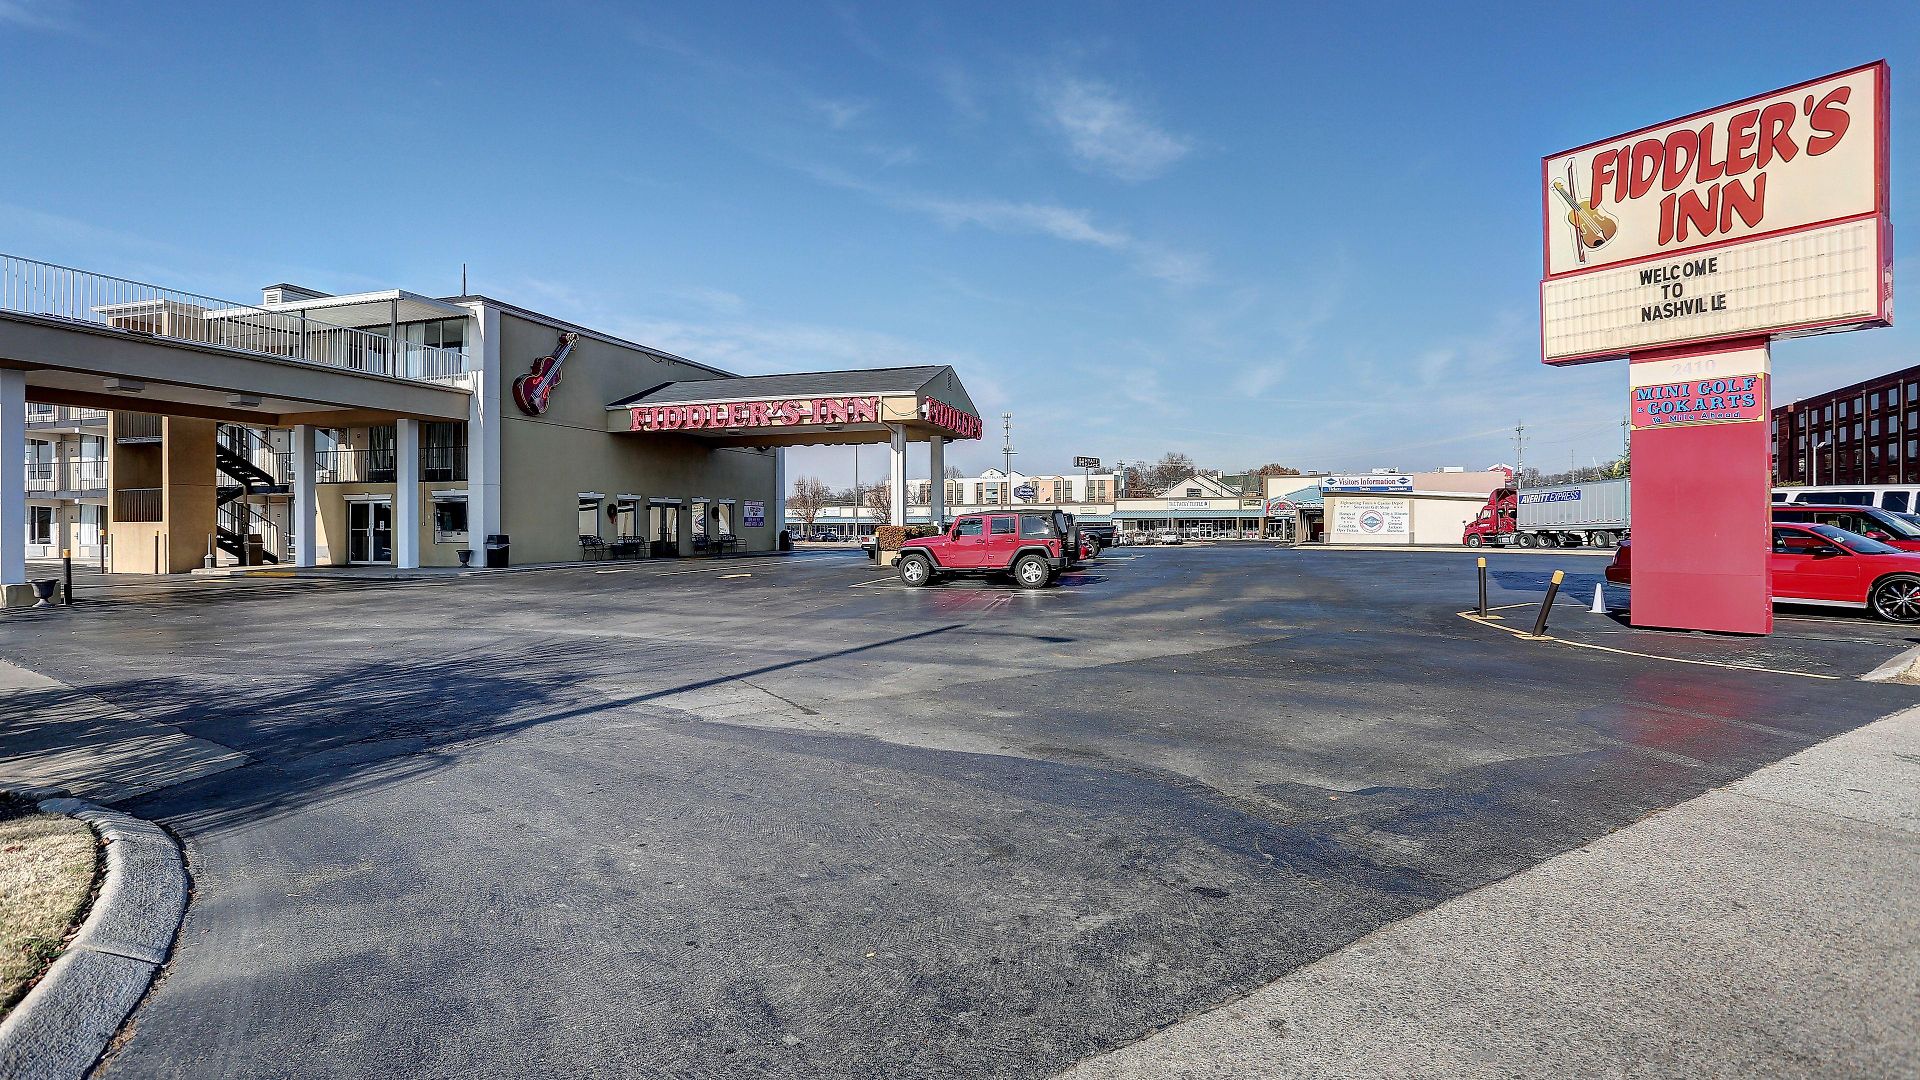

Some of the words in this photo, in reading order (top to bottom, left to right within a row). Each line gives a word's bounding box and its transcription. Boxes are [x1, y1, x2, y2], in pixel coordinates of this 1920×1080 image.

[1589, 86, 1852, 210] FIDDLER'S
[1657, 171, 1768, 247] INN
[1639, 257, 1719, 286] WELCOME
[1661, 282, 1685, 301] TO
[1671, 360, 1716, 376] 2410
[1636, 383, 1690, 401] MINI
[1697, 377, 1757, 396] GOLF
[629, 400, 801, 431] FIDDLER'S
[811, 396, 878, 424] INN
[1647, 393, 1757, 415] GOKARTS
[1669, 413, 1695, 423] Mile
[1701, 411, 1741, 419] Ahead
[1338, 478, 1360, 486] Visitors
[1360, 477, 1396, 486] Information
[1521, 493, 1549, 504] AVERITT
[1550, 490, 1580, 502] EXPRESS
